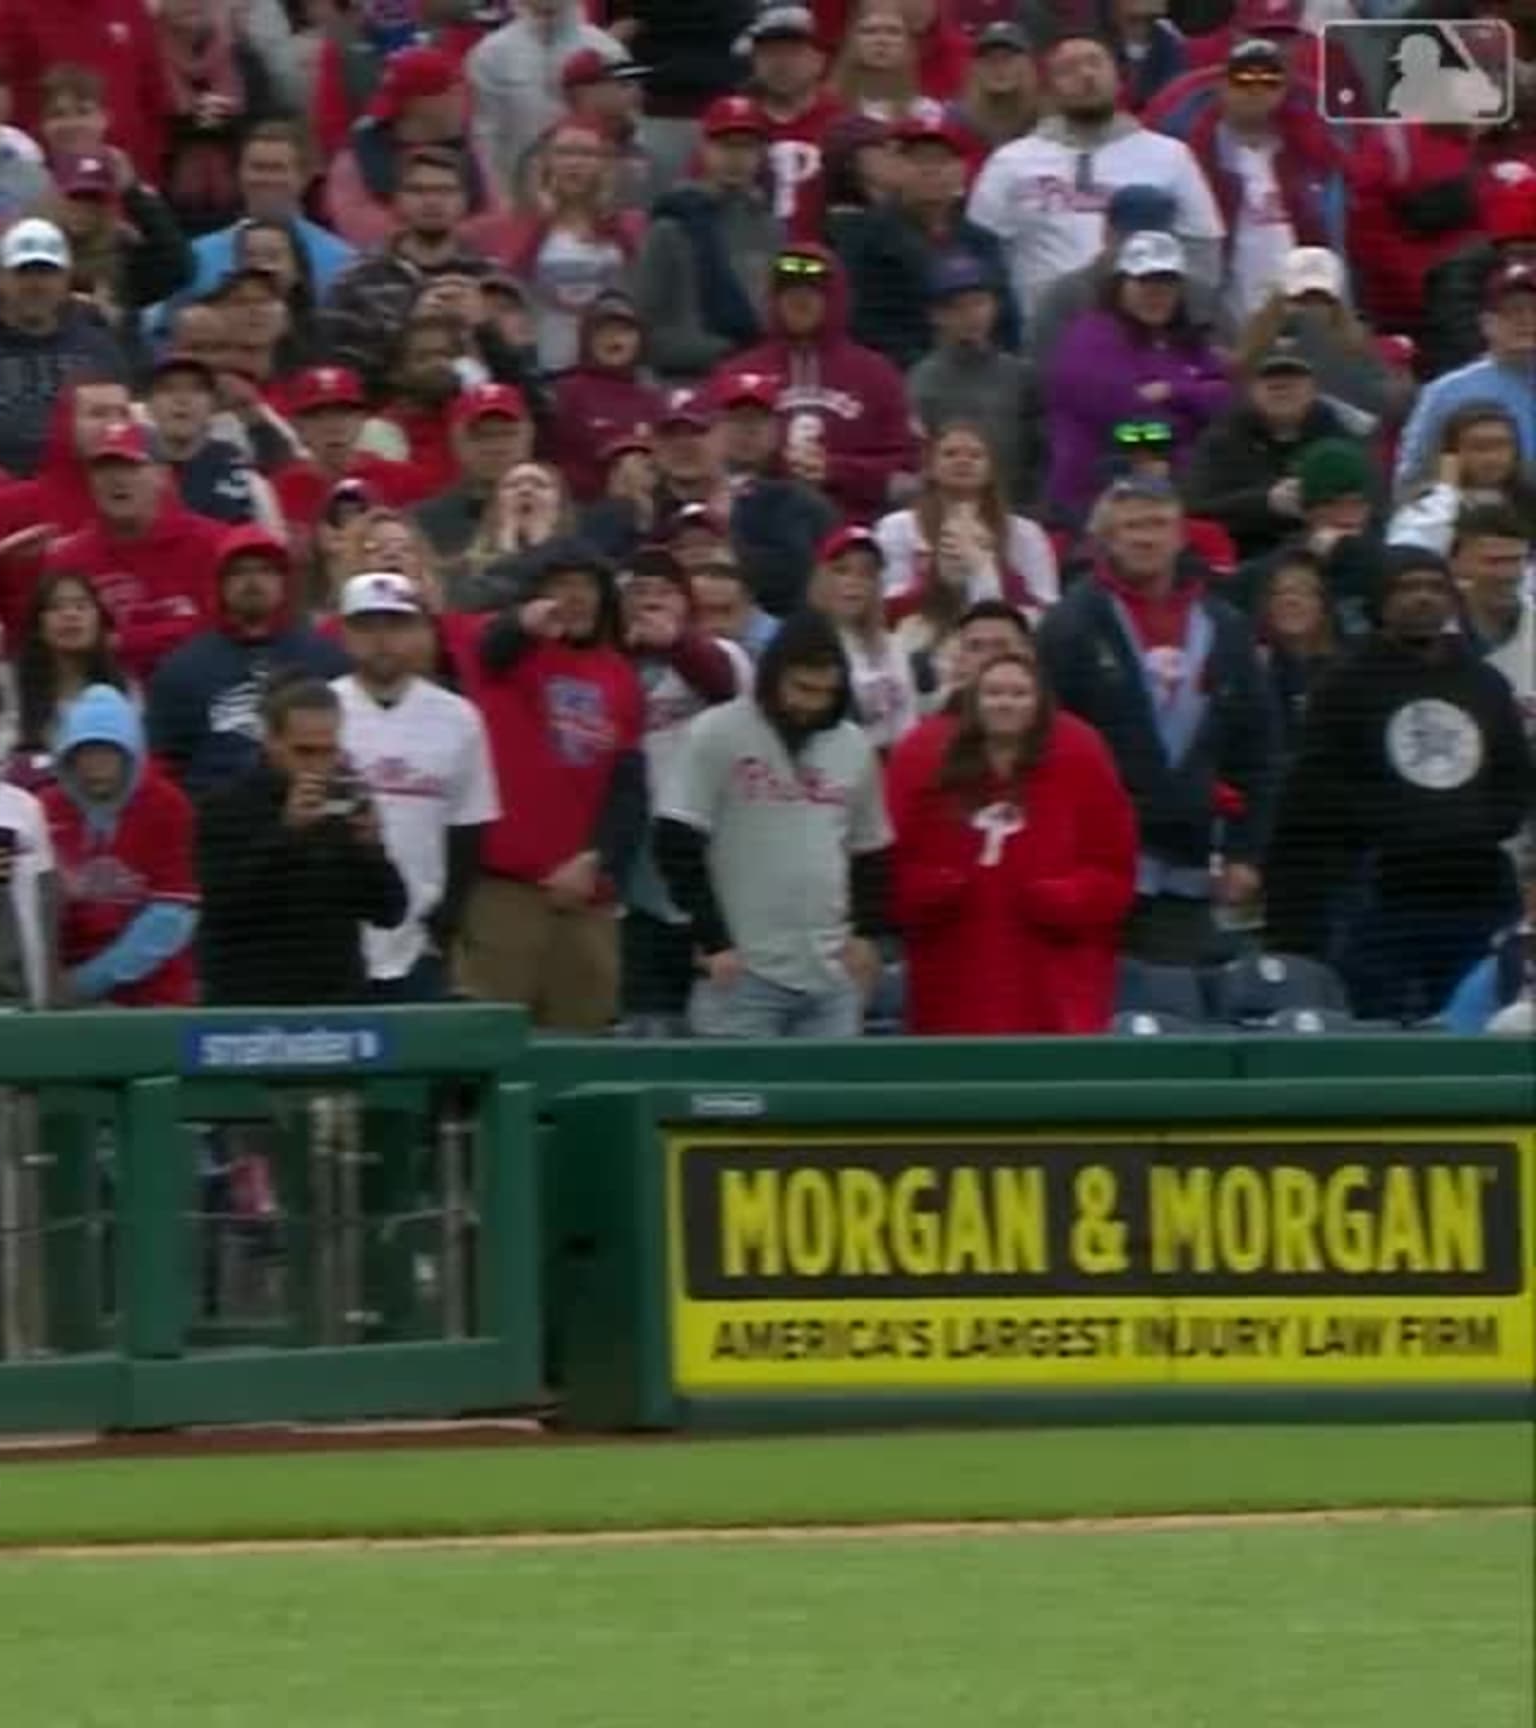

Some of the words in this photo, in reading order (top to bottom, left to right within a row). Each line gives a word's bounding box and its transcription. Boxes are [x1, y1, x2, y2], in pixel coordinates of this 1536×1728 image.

[720, 1166, 1048, 1275] MORGAN
[1070, 1166, 1128, 1273] &
[1150, 1165, 1483, 1273] MORGAN
[711, 1320, 931, 1360] AMERICA'S
[944, 1318, 1122, 1358] LARGEST
[1135, 1317, 1284, 1357] INJURY
[1299, 1317, 1384, 1356] LAW
[1398, 1316, 1499, 1356] FIRM
